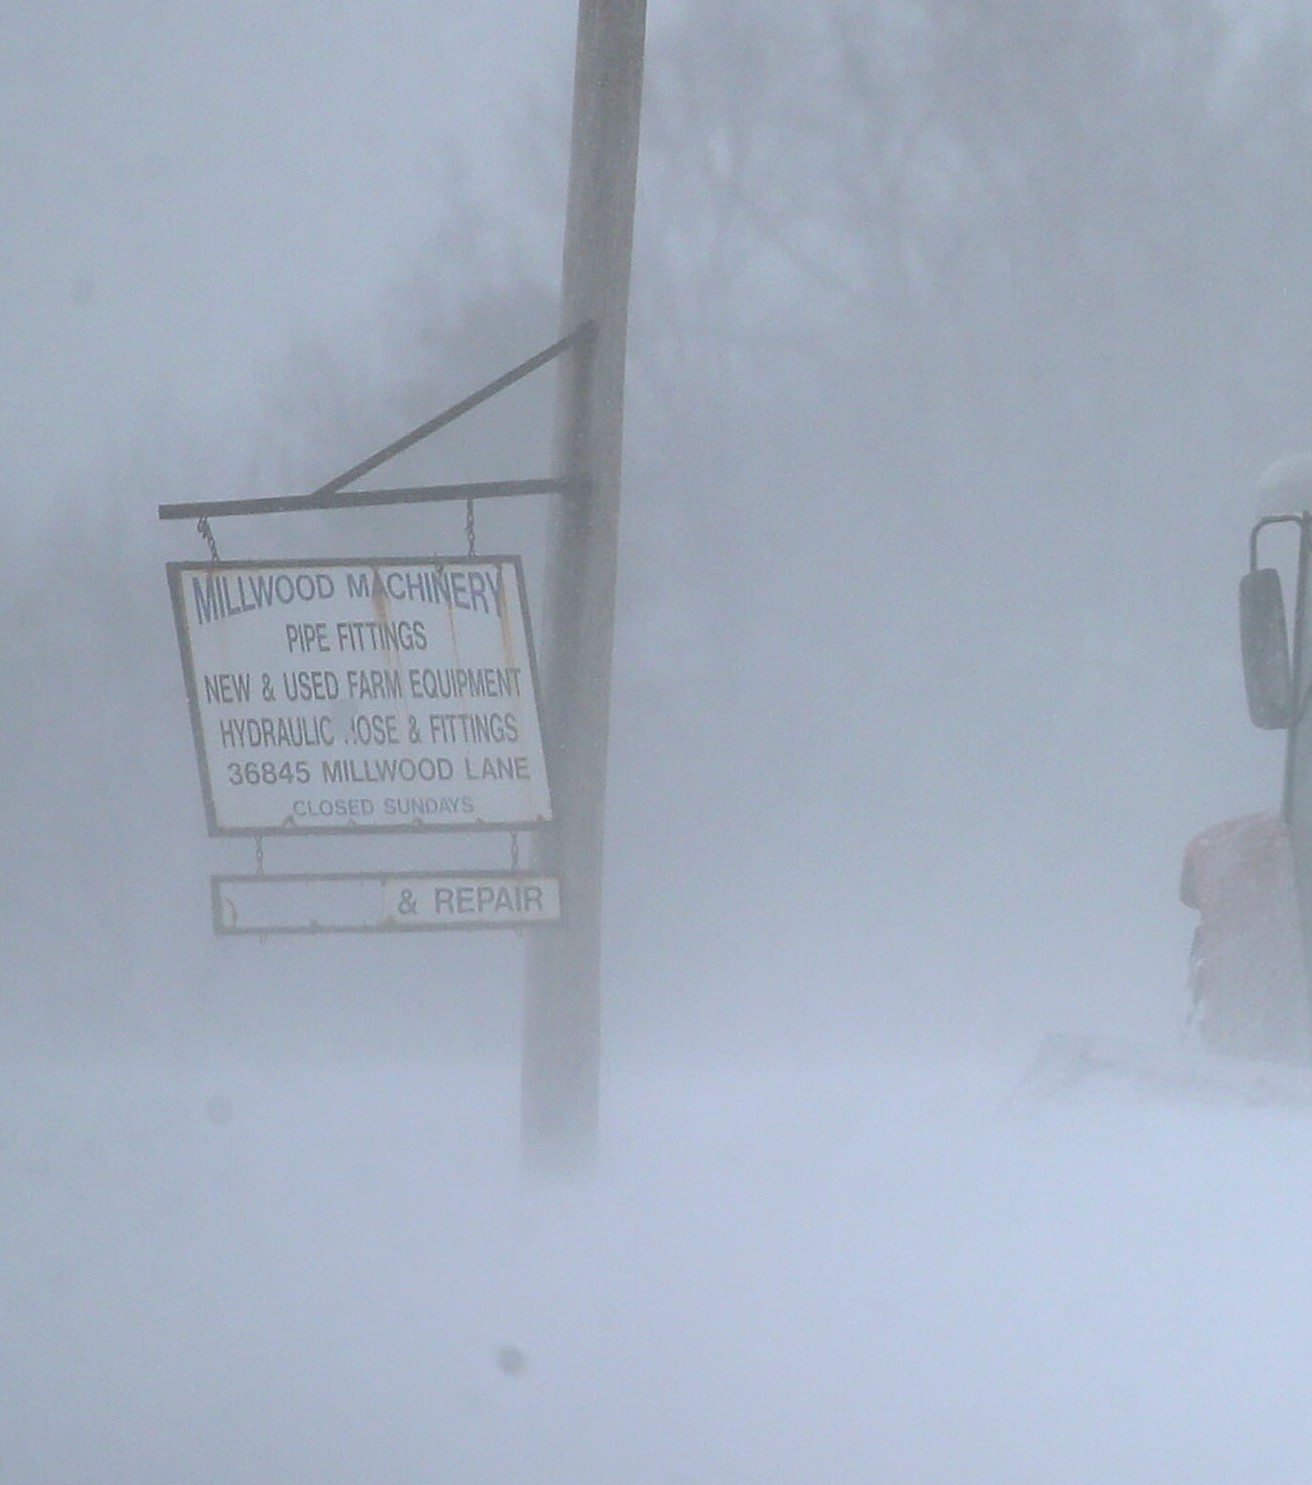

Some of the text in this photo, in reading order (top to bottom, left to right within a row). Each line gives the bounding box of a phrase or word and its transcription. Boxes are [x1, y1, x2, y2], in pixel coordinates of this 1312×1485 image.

[192, 573, 334, 625] MILLWOOD
[286, 620, 428, 653] PIPE FITTINGS
[204, 667, 521, 704] NEW & USED FARM EQUIPMENT
[220, 715, 334, 749] HYDRAULIC
[409, 714, 422, 743] &
[429, 712, 518, 743] FITTINGS
[227, 756, 531, 785] 36845 MILLWOOD LANE
[293, 796, 474, 816] CLOSED SUNDAYS
[397, 886, 543, 914] & REPAIR
